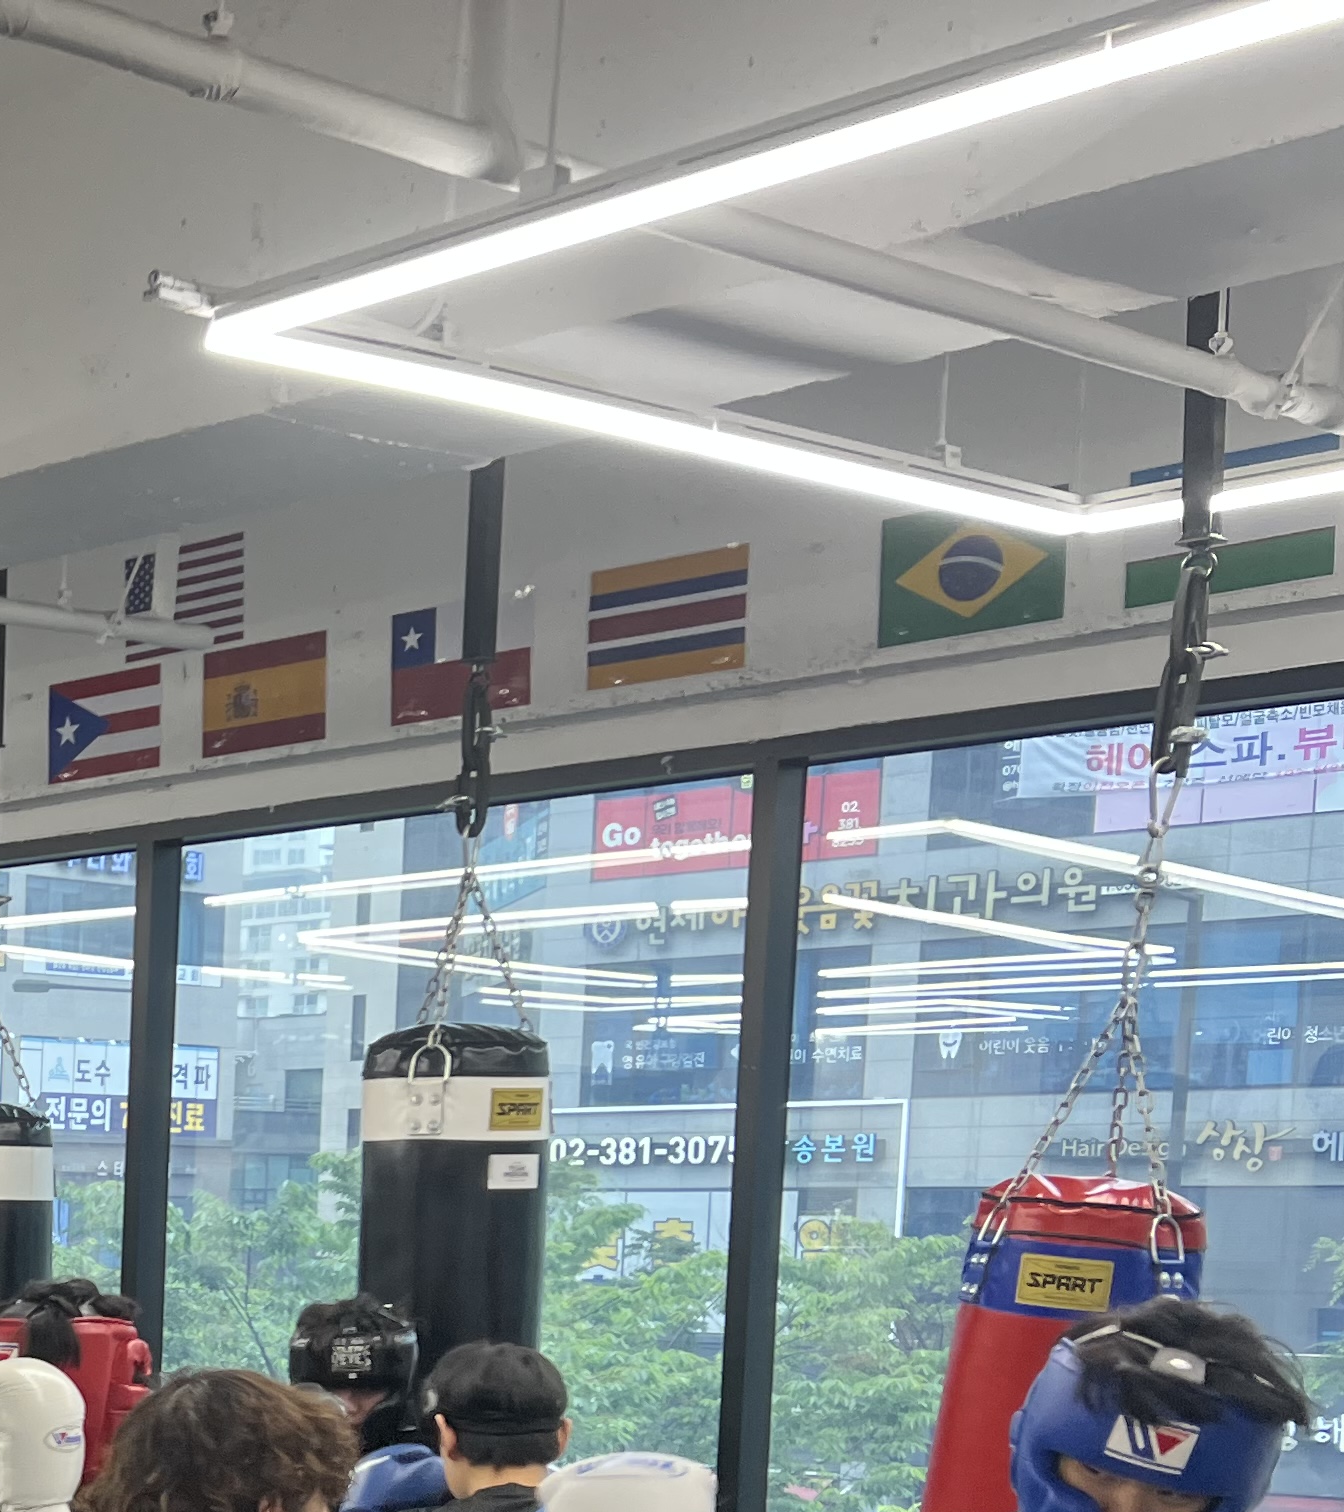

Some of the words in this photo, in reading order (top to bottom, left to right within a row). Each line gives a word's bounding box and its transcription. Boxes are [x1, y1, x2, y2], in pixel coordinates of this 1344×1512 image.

[602, 822, 641, 847] Go
[75, 1058, 111, 1087] 도수
[44, 1095, 112, 1132] 전문의
[1062, 1139, 1105, 1158] Hair
[1026, 1272, 1103, 1294] SPART
